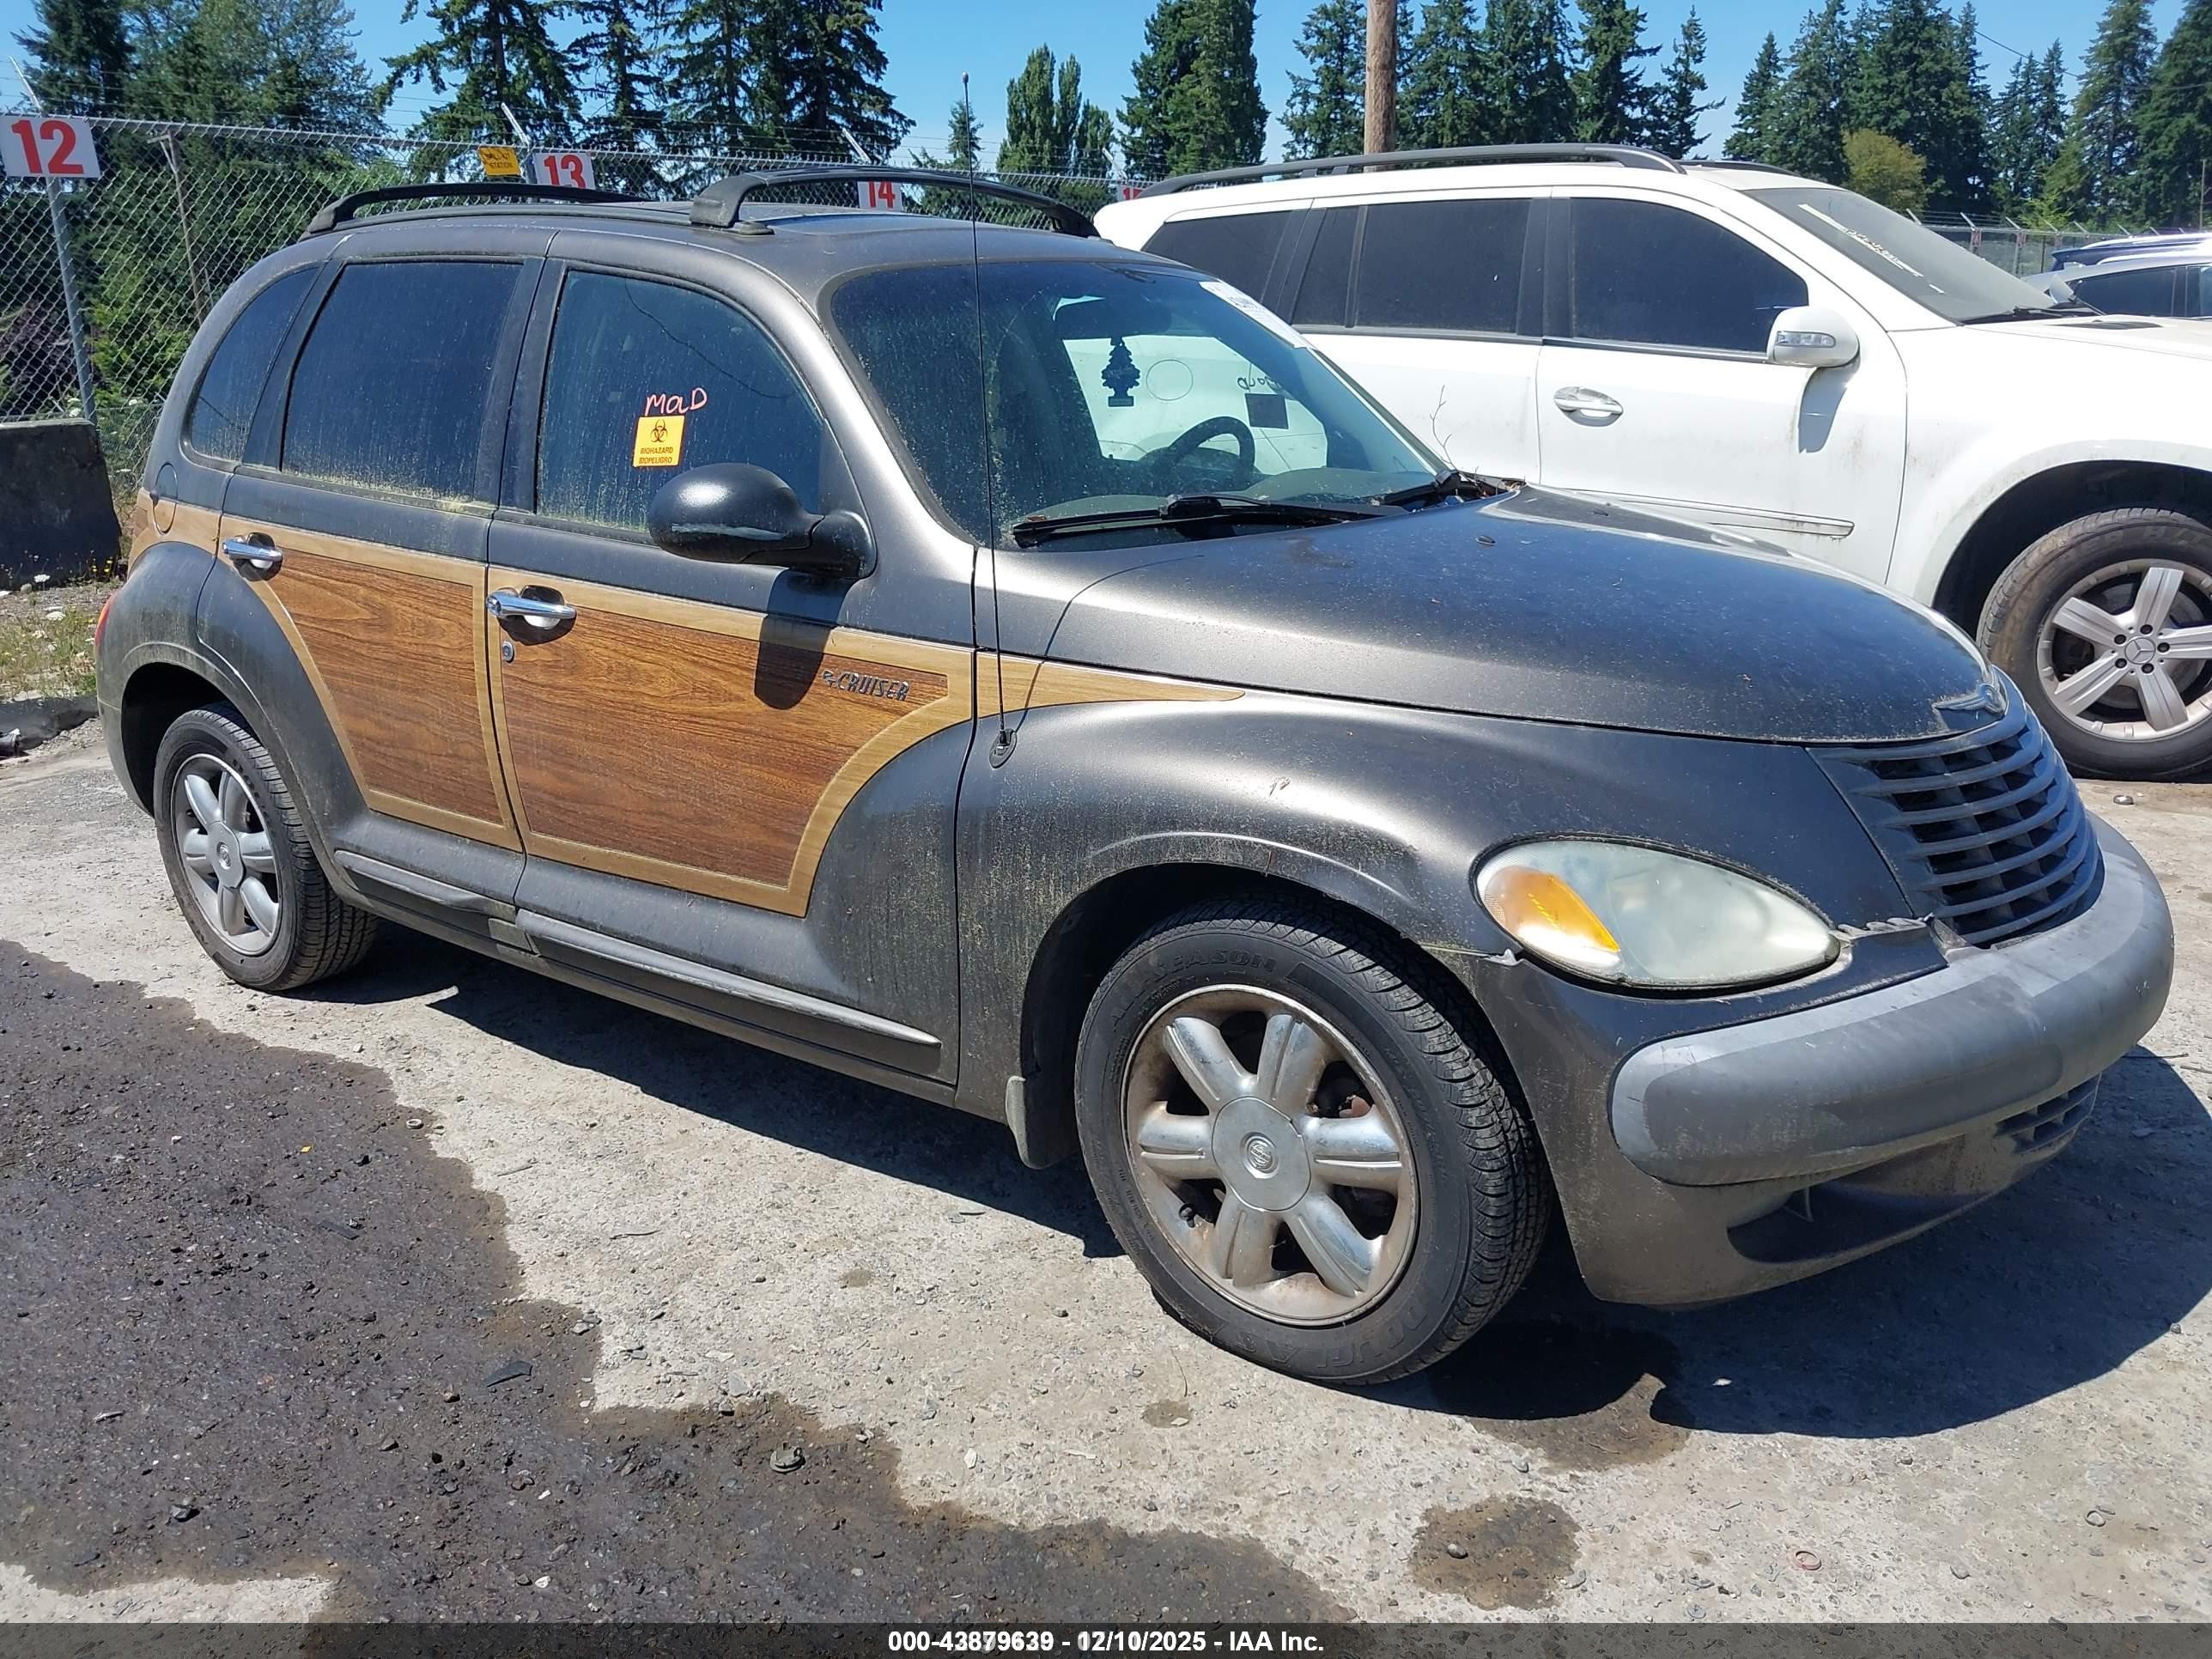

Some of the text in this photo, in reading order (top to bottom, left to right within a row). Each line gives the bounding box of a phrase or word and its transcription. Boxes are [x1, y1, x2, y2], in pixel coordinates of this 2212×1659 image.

[11, 119, 84, 173] 12
[544, 154, 586, 189] 13
[868, 179, 896, 208] 14
[836, 671, 911, 701] CRUISER
